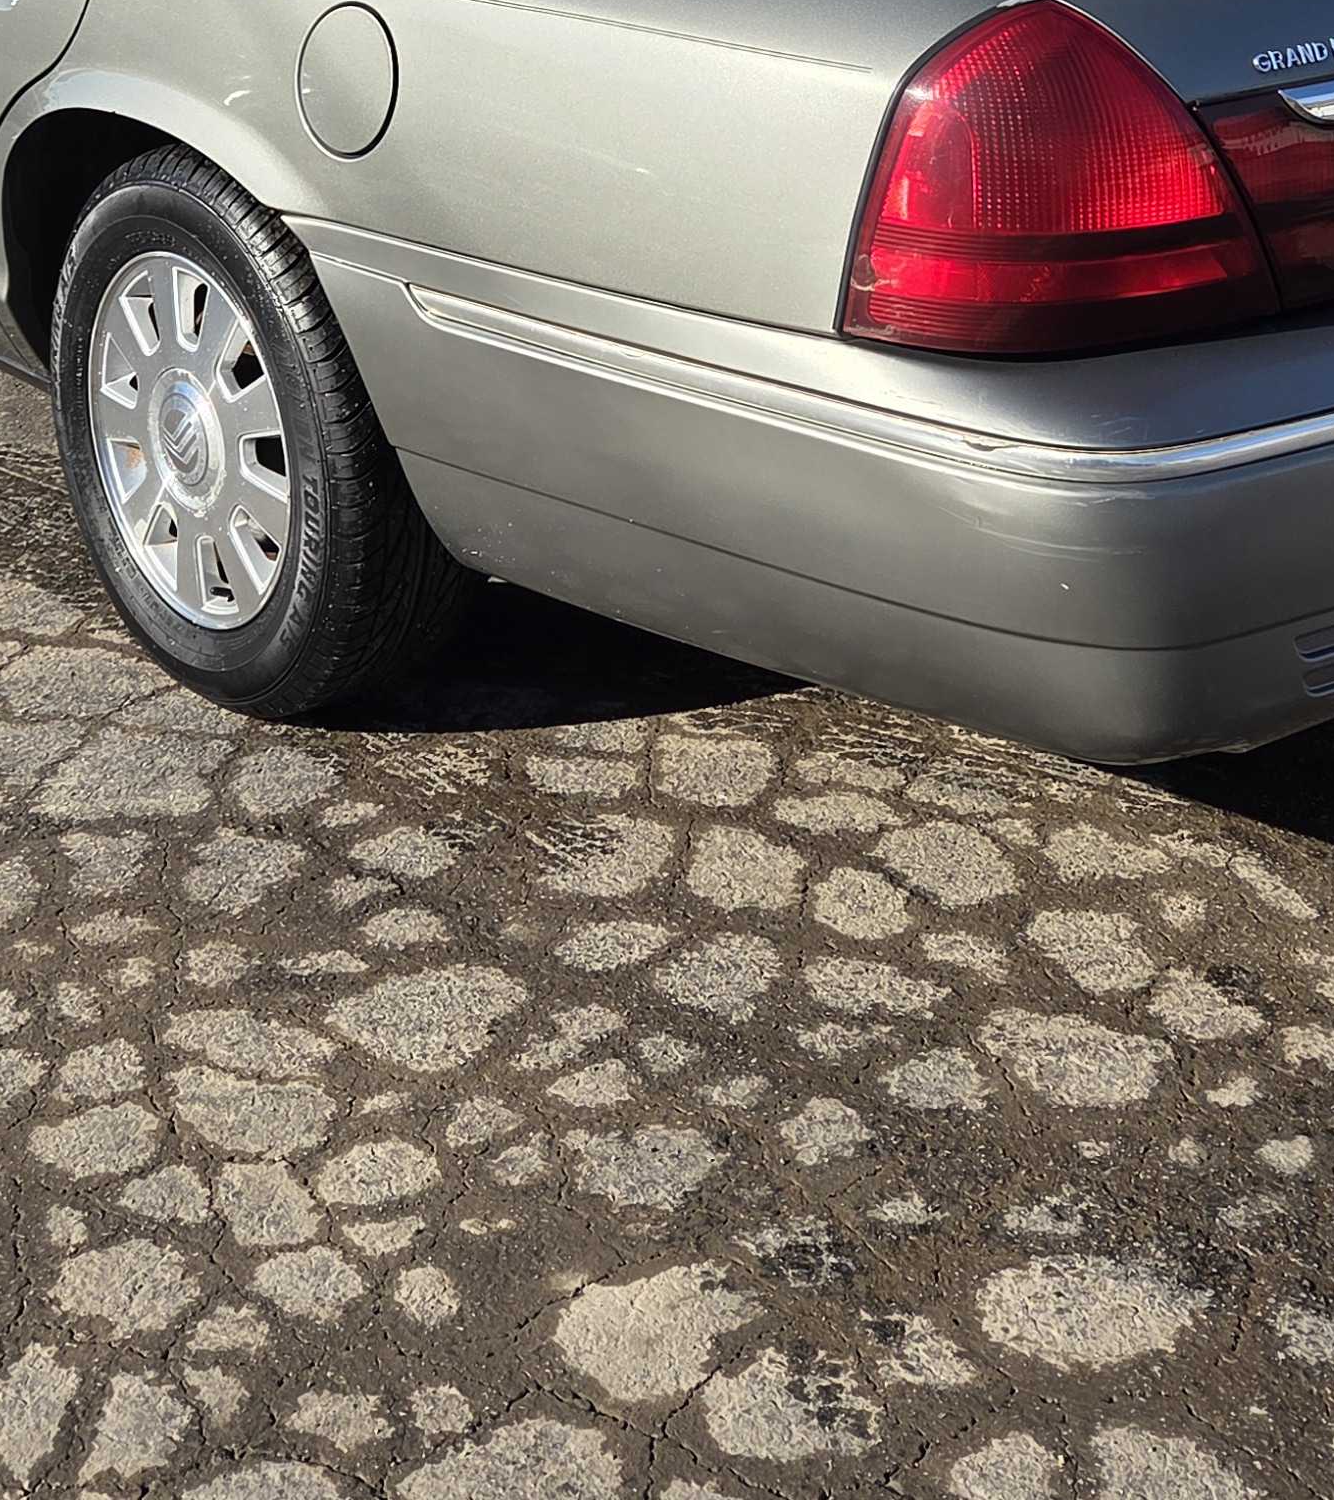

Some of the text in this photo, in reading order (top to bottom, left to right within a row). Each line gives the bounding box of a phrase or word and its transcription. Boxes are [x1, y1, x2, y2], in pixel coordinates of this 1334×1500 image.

[1251, 41, 1329, 73] GRAND
[297, 472, 321, 600] TOURING
[278, 602, 309, 647] A/S
